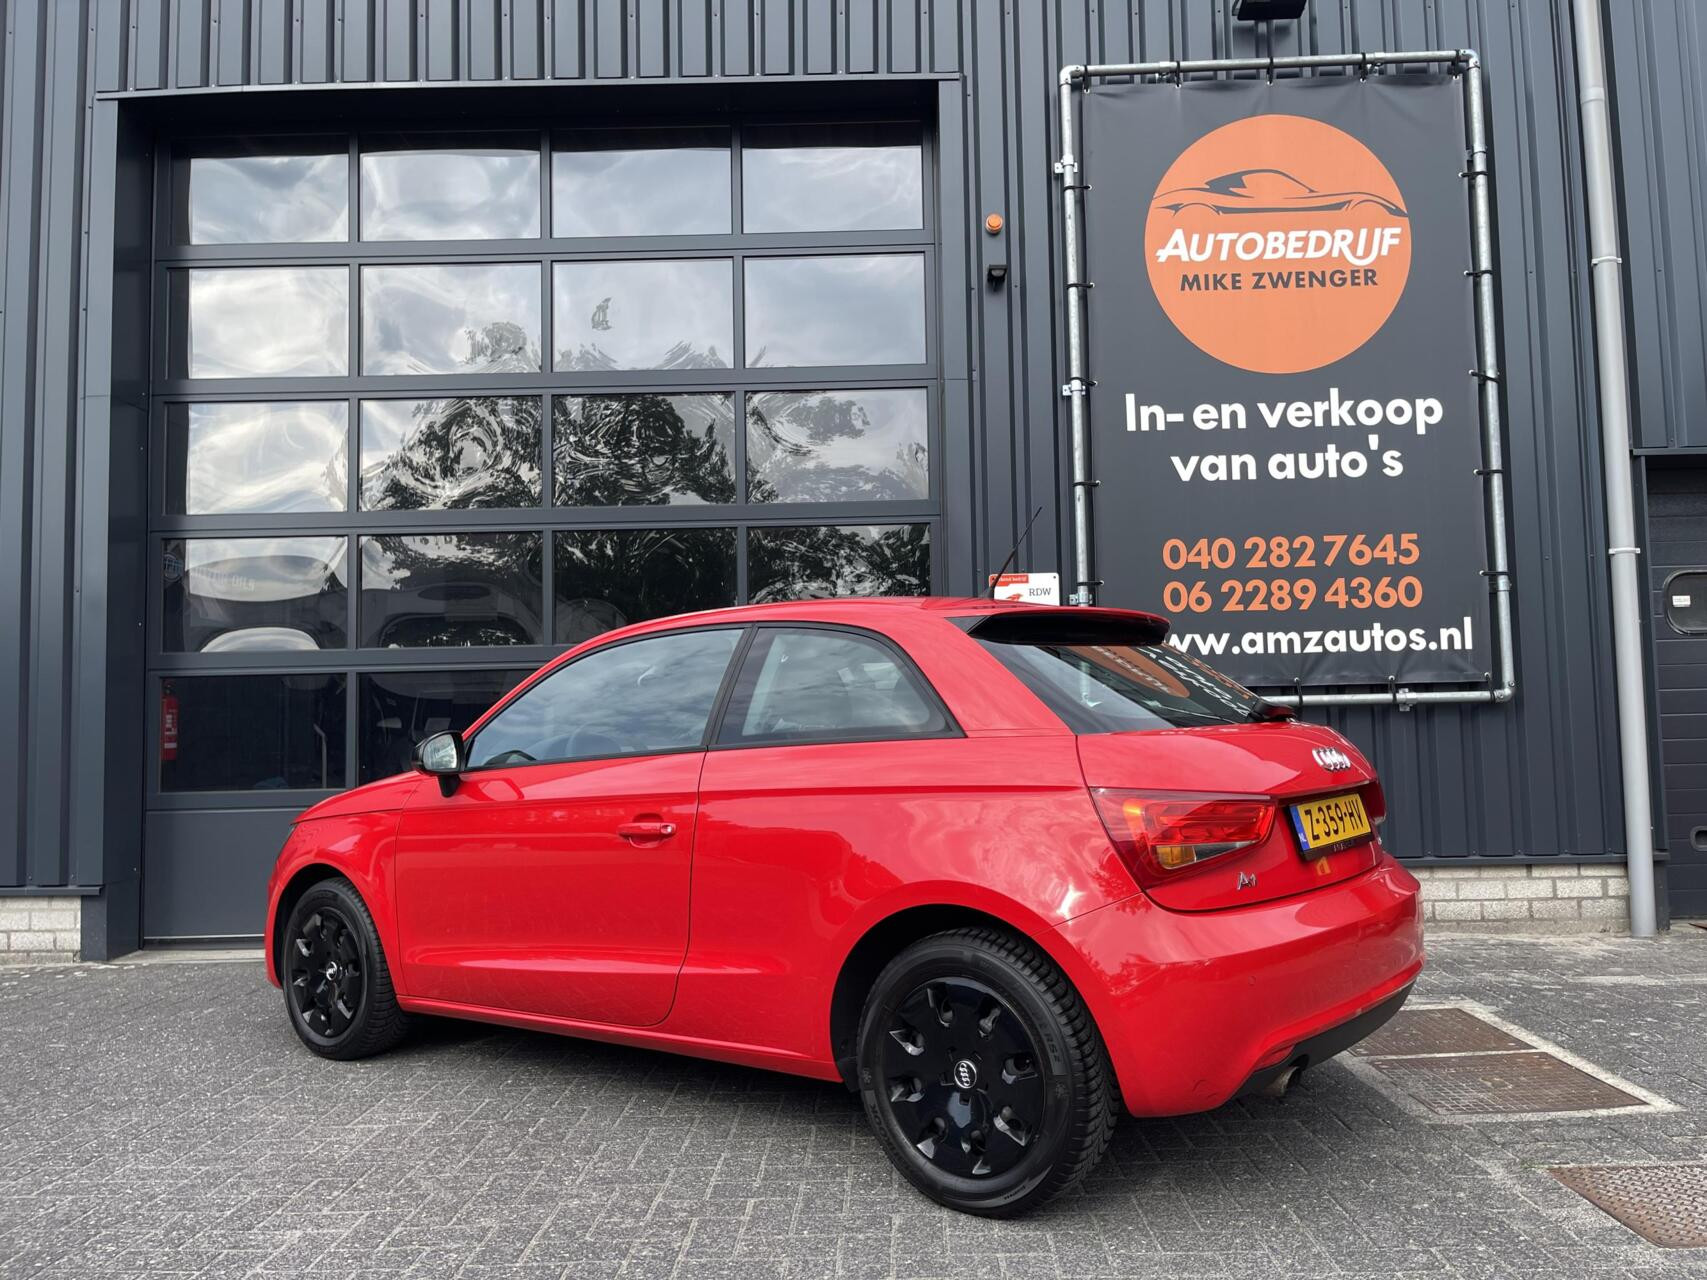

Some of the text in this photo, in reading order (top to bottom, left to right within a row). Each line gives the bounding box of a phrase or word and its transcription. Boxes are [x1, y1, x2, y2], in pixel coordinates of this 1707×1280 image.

[1155, 228, 1402, 266] AUTOBEDRIJF
[1180, 268, 1378, 292] MIKE ZWENGER
[1125, 388, 1443, 435] In- en verkoop
[1170, 434, 1404, 481] van auto's
[1162, 533, 1420, 570] 040 282 7645
[1028, 588, 1052, 597] RDW
[1163, 575, 1423, 613] 06 2289 4360
[1303, 799, 1364, 841] Z-359-HV
